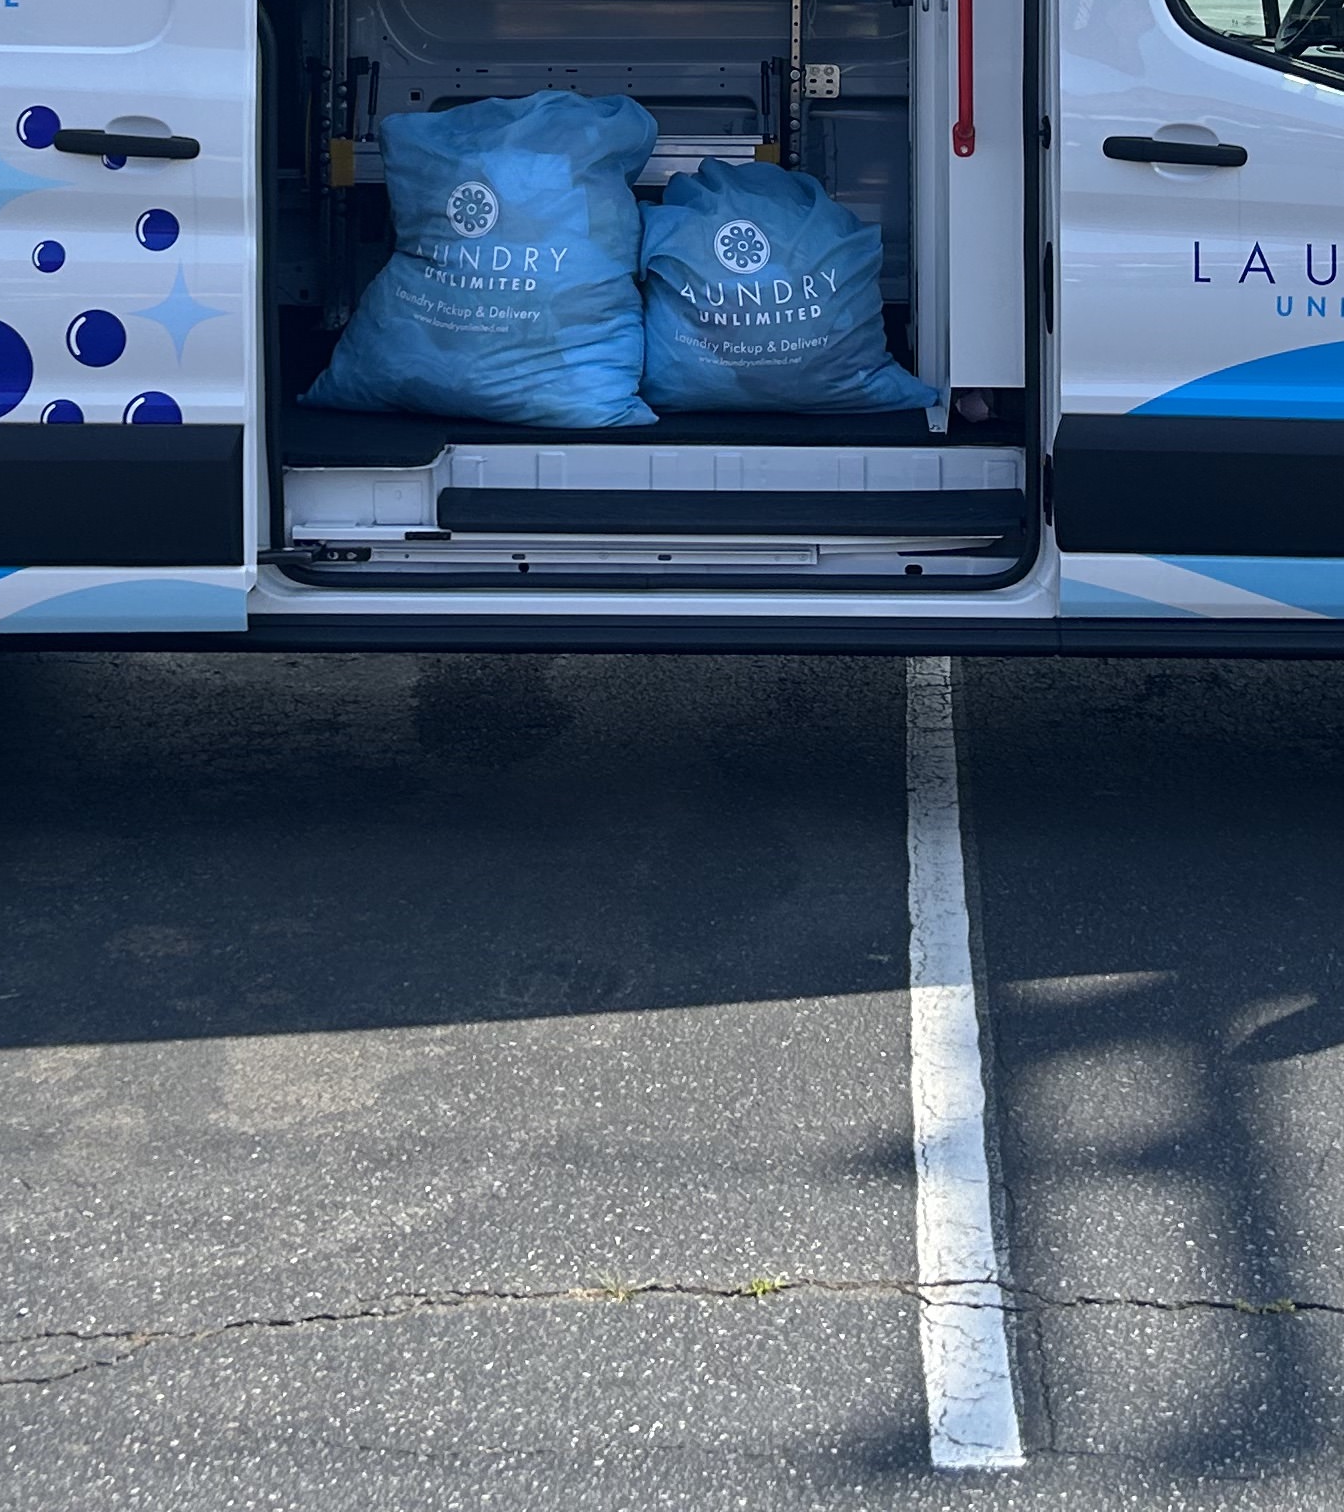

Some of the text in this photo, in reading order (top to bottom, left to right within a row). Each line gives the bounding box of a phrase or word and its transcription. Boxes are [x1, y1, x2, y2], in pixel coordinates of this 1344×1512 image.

[415, 244, 568, 273] AUNDRY
[424, 266, 537, 291] UNLIMITED
[680, 268, 837, 307] AUNDRY
[395, 286, 541, 323] Laundry Pickup & Delivery
[699, 305, 822, 326] UNLIMITED
[674, 329, 829, 355] Laundry Pickup & Delivery
